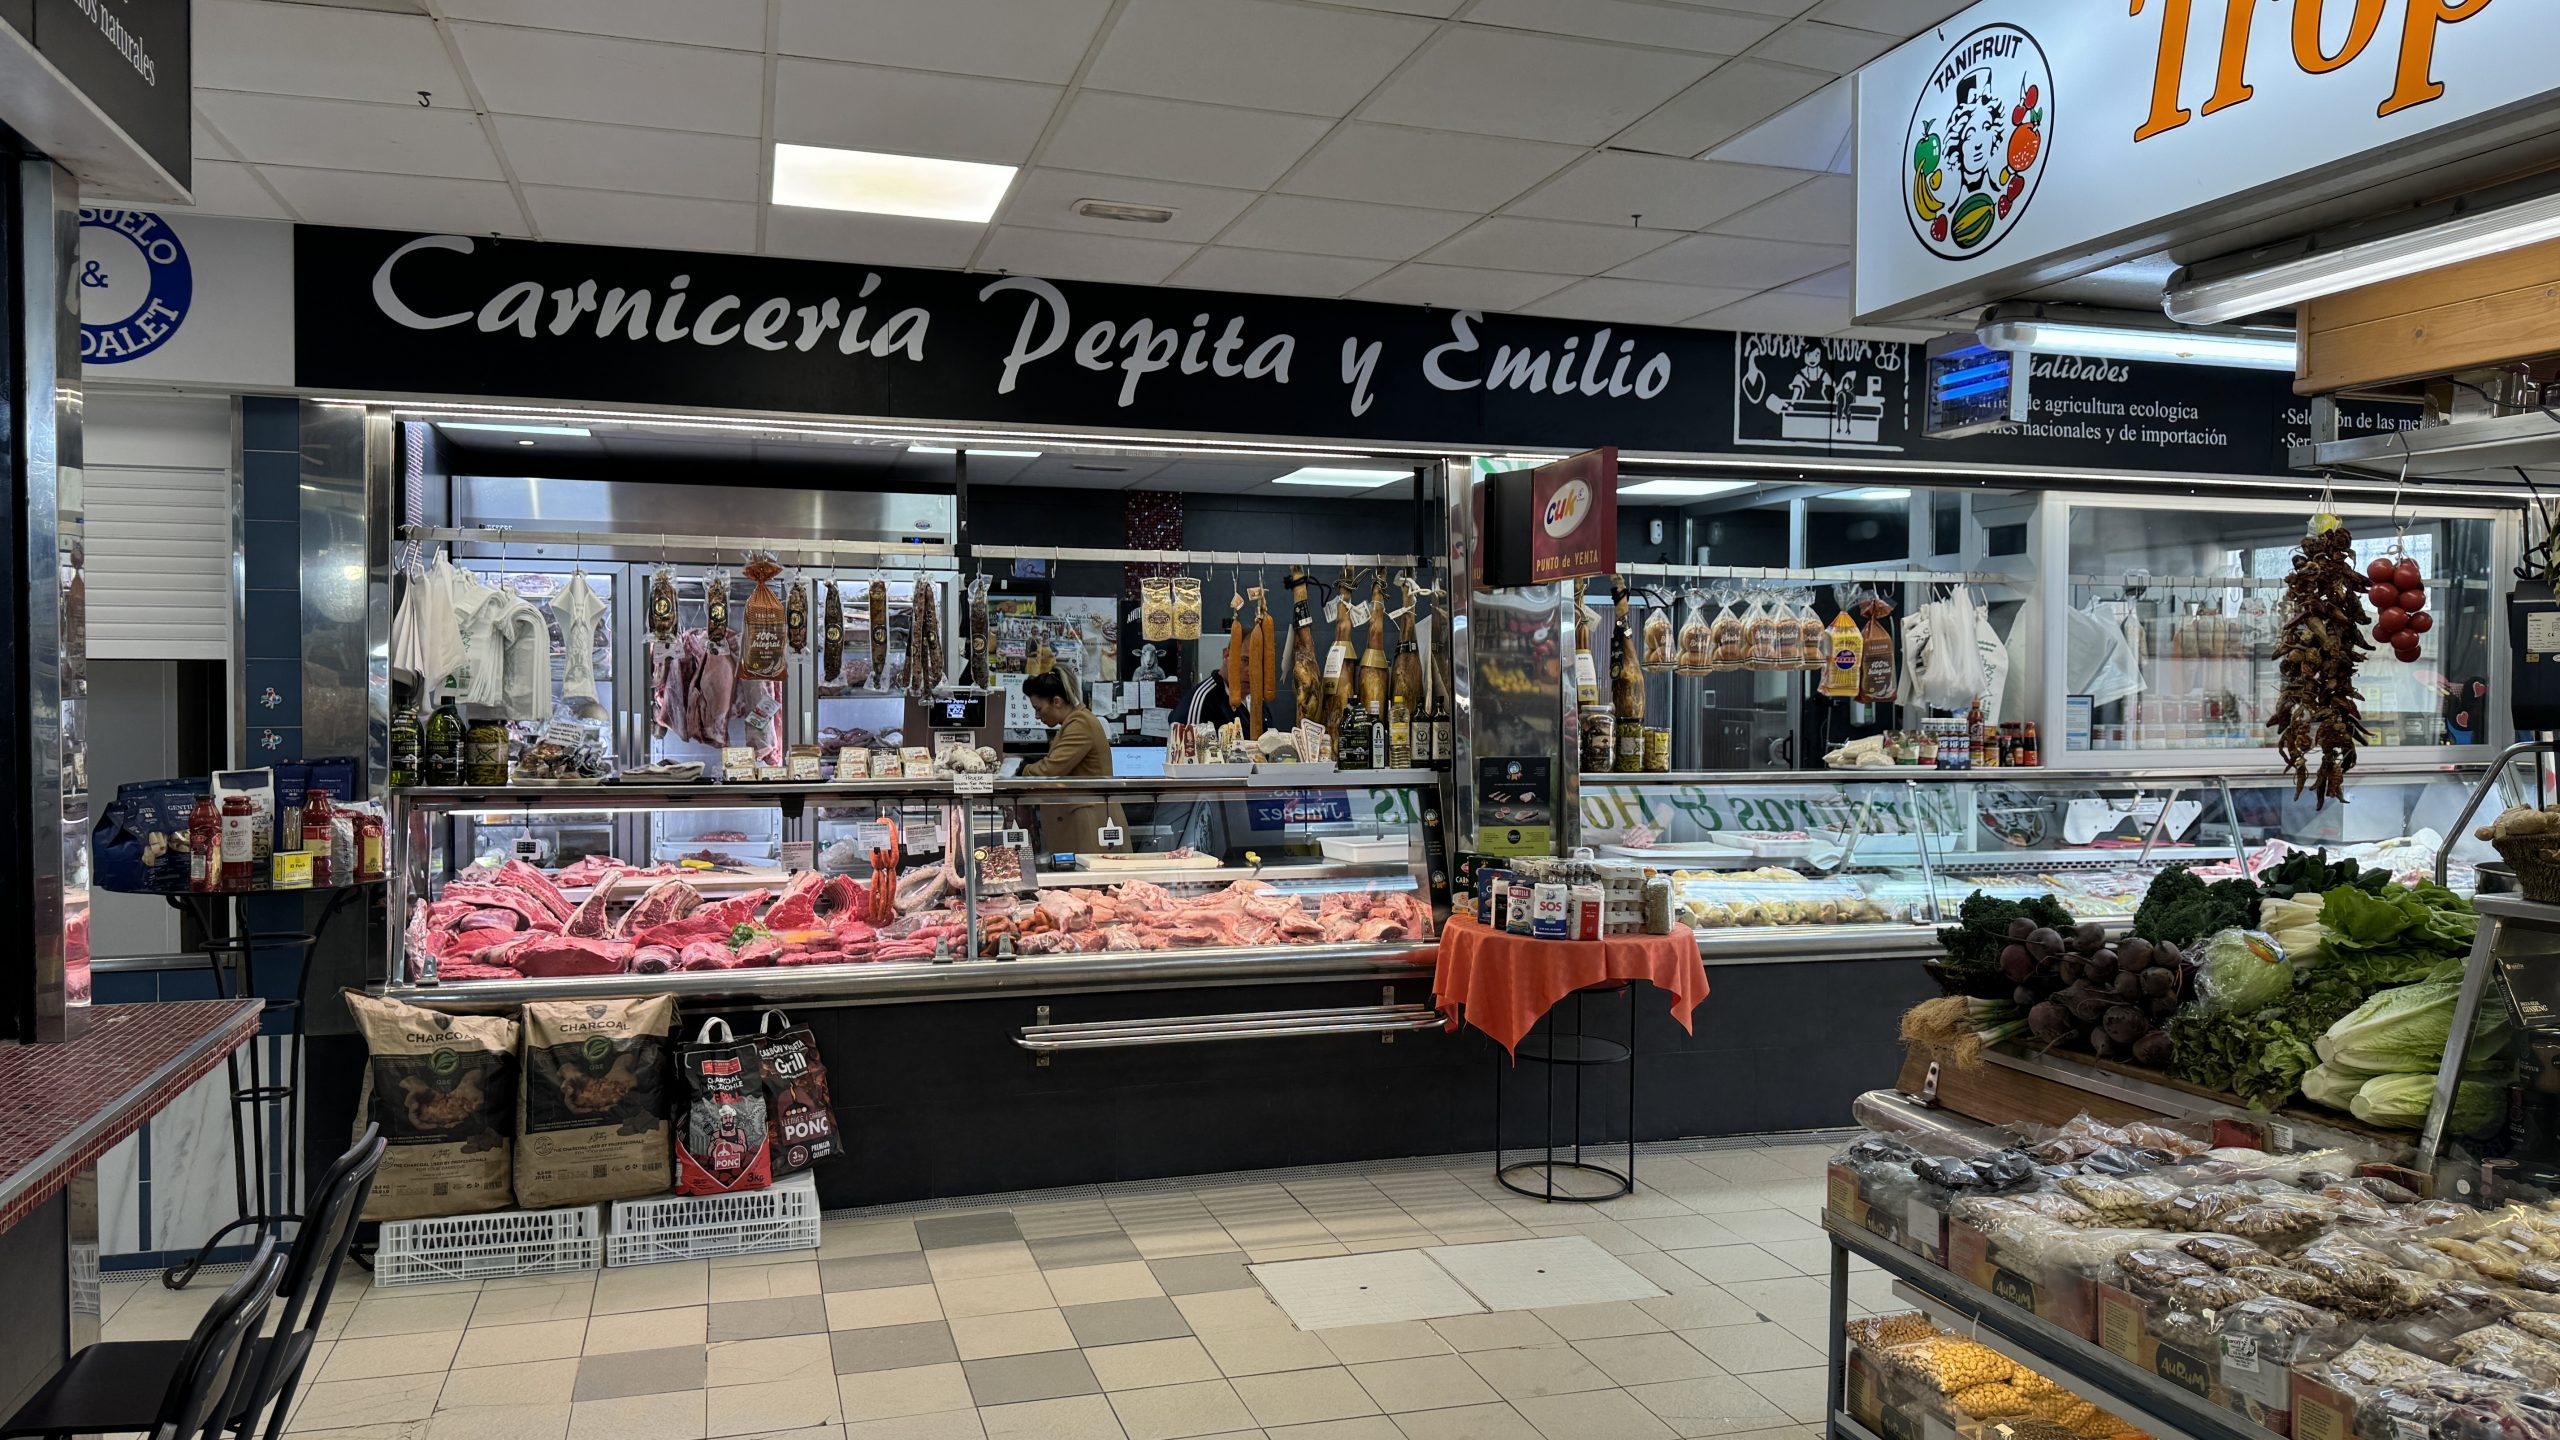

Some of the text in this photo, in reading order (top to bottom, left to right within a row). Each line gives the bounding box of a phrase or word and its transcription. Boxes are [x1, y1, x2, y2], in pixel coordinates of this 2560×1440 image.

[100, 4, 155, 87] naturales
[1933, 34, 2024, 95] TANIFRUIT
[80, 260, 108, 288] &
[372, 235, 1672, 417] Carnicería Pepita y Emilio
[2030, 354, 2130, 383] ialidades
[2044, 395, 2125, 417] agricultura
[2129, 401, 2199, 420] ecologica
[2356, 411, 2373, 429] de
[2376, 412, 2395, 430] las
[2023, 420, 2102, 439] nacionales
[2105, 427, 2116, 444] y
[2119, 424, 2137, 441] de
[2141, 426, 2228, 447] importación
[1536, 549, 1599, 573] PUNTO de VENTA
[1539, 900, 1562, 912] SOS
[2521, 1004, 2549, 1013] GINSENG
[406, 1031, 481, 1043] CHARCOAL
[560, 1019, 630, 1033] CHARCOAL
[774, 1052, 808, 1074] Grill
[784, 1116, 829, 1141] PONÇ
